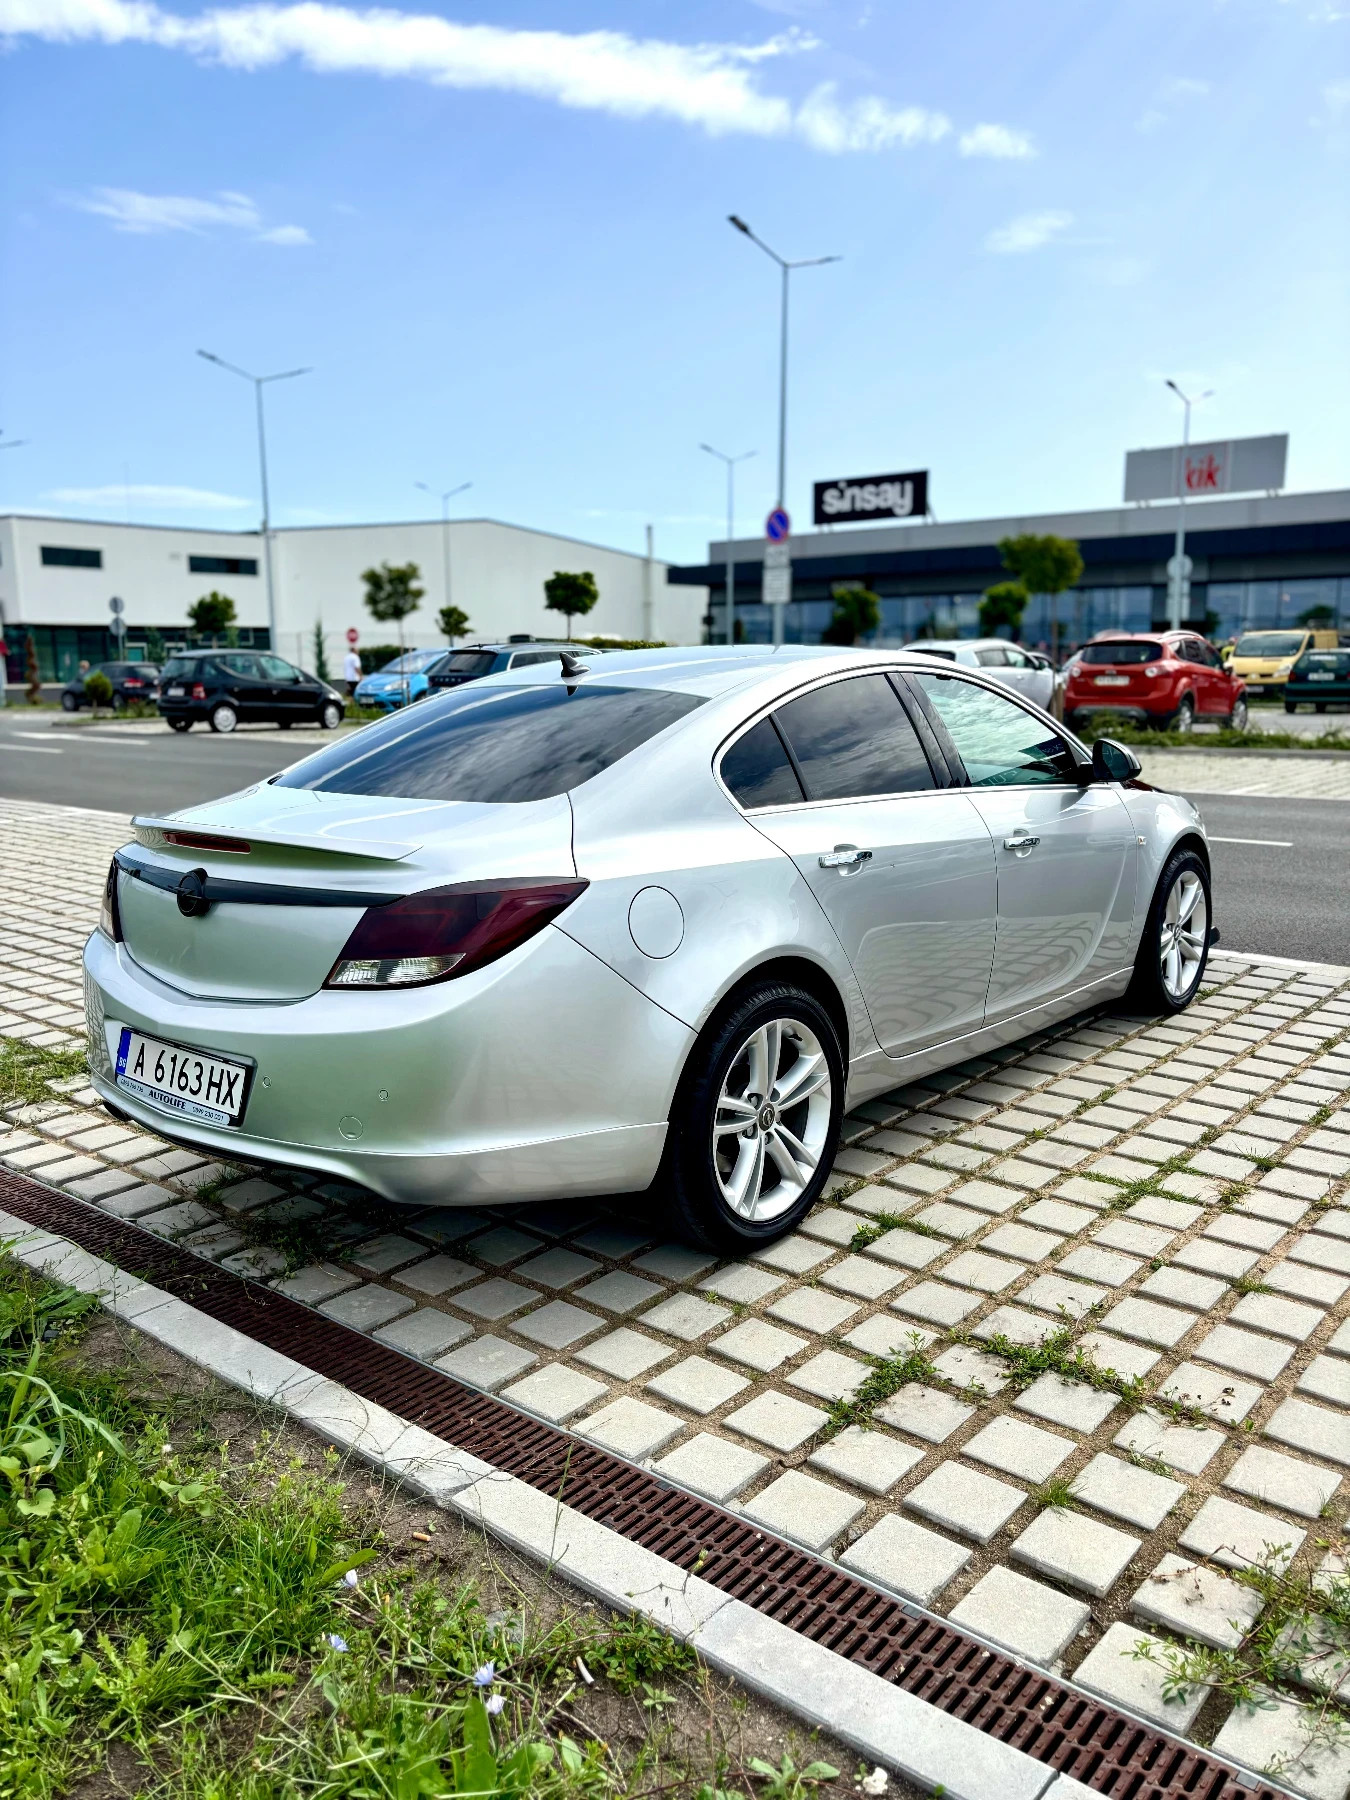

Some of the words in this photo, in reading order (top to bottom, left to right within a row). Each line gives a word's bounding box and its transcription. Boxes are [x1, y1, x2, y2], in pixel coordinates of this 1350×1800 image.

[821, 480, 914, 516] sinsay
[133, 1042, 146, 1077] A
[148, 1089, 187, 1110] AUTOLIFE
